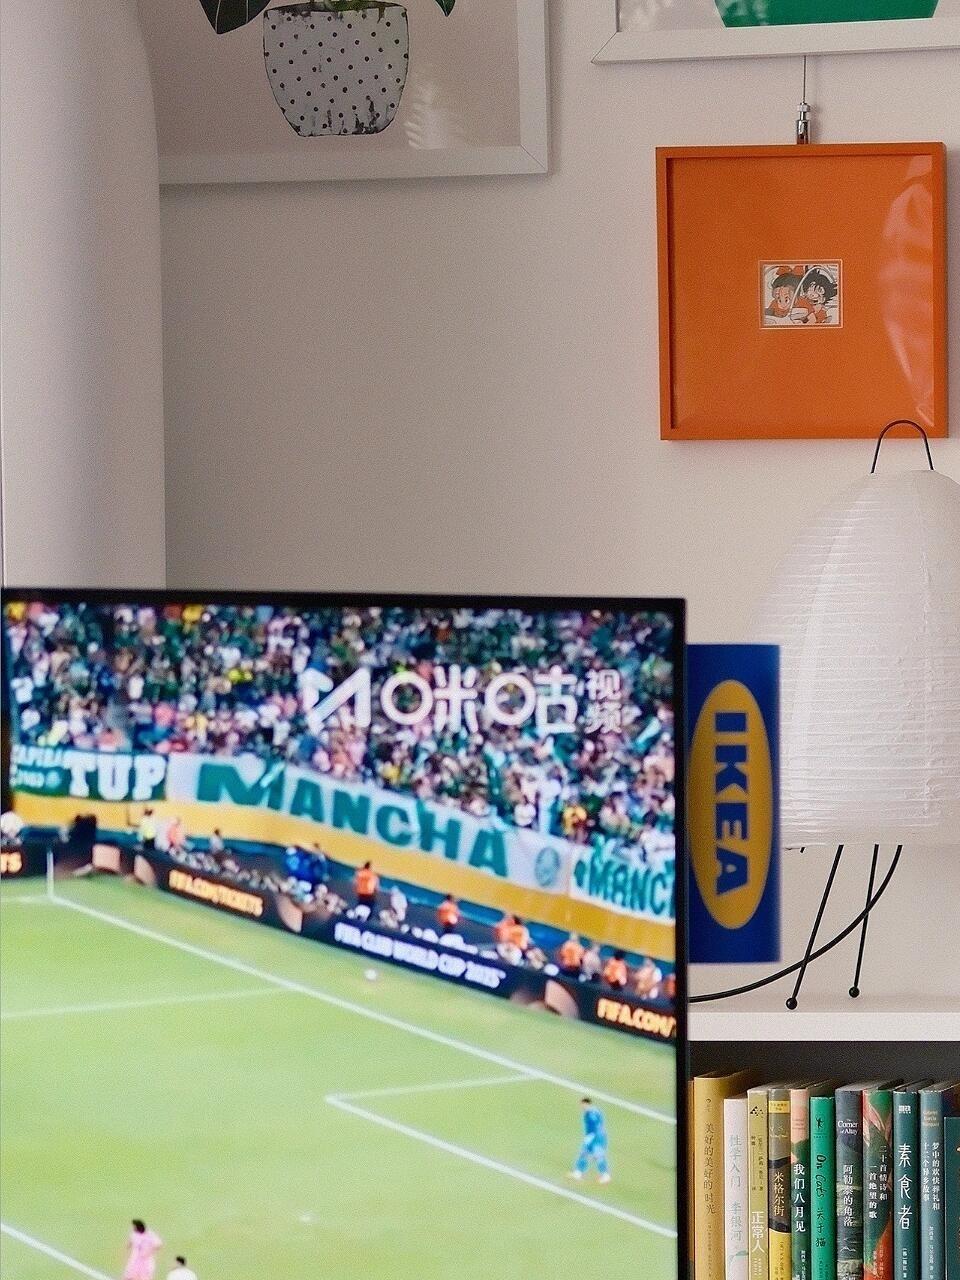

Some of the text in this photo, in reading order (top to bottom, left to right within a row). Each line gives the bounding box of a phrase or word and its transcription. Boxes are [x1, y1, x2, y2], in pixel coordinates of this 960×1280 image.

[196, 762, 508, 878] MANCHA
[713, 711, 749, 896] IKEA
[588, 853, 674, 916] MANC
[730, 1135, 743, 1242] 性学入门 李银河
[774, 1171, 785, 1217] 米格尔街
[793, 1164, 806, 1232] 我们八月见
[843, 1164, 854, 1227] 阿勒泰的角落
[898, 1143, 913, 1230] 素食者
[752, 1211, 765, 1253] 正常人
[816, 1207, 827, 1248] 关于猫
